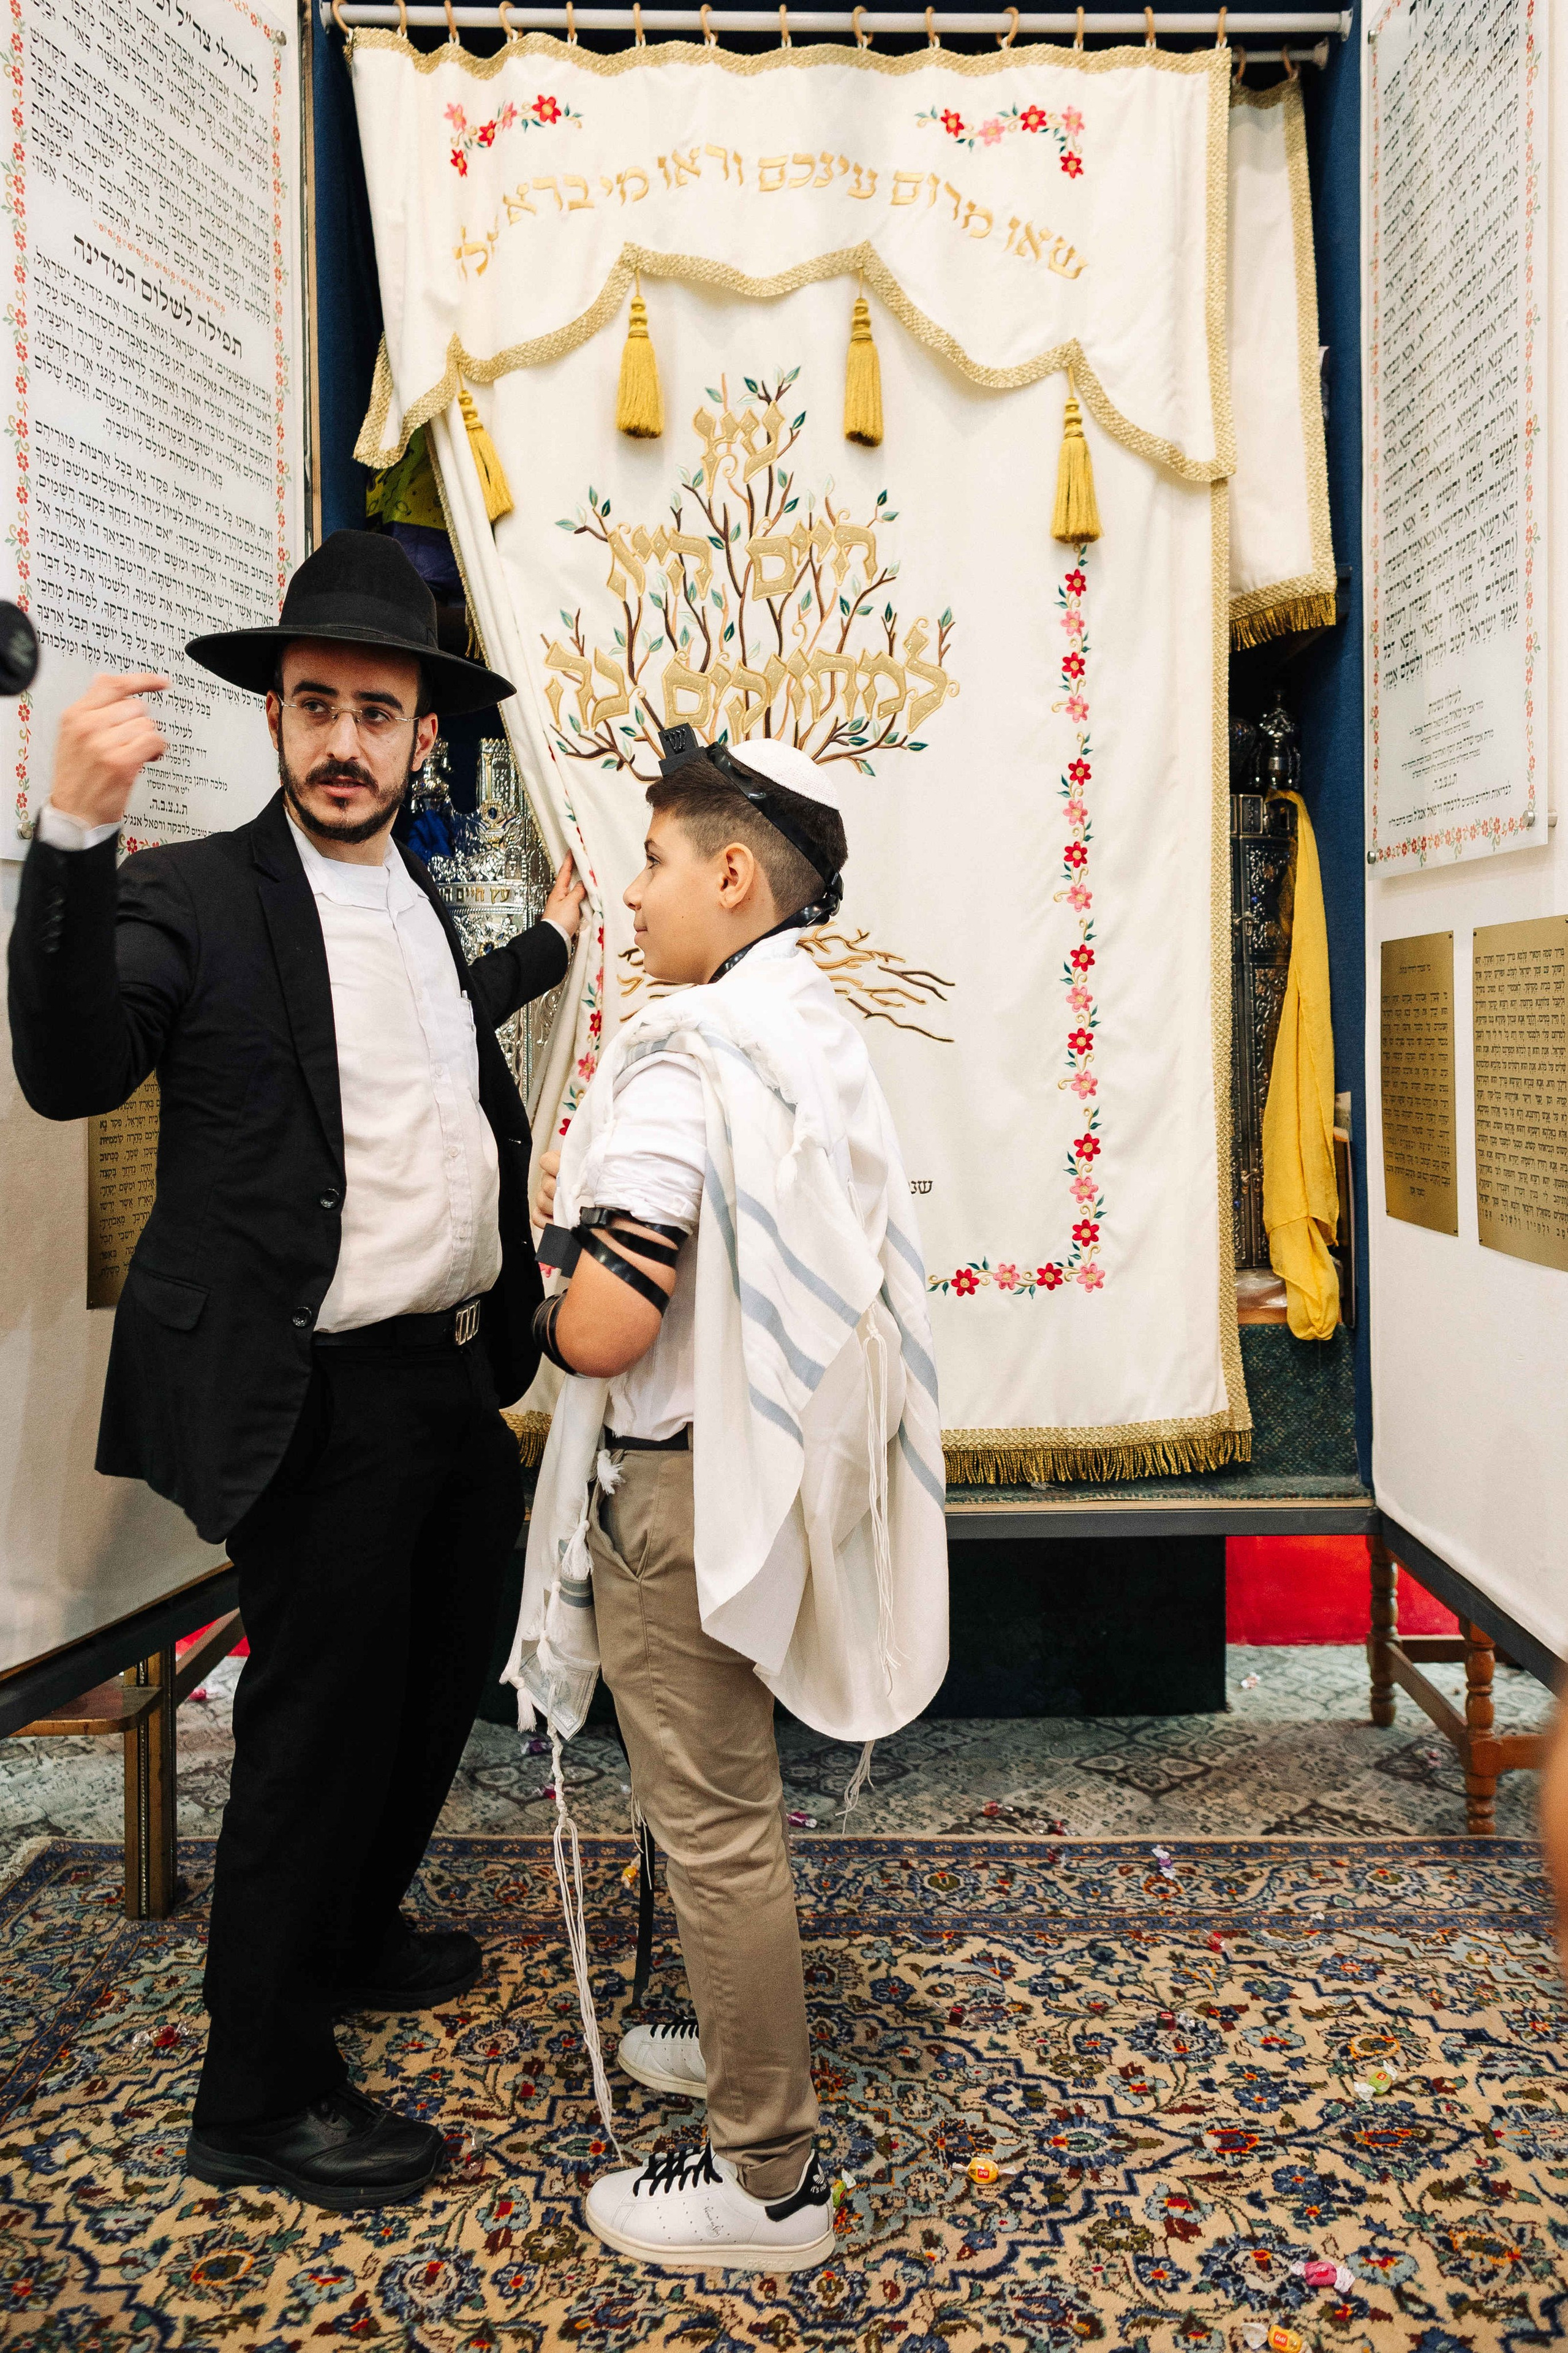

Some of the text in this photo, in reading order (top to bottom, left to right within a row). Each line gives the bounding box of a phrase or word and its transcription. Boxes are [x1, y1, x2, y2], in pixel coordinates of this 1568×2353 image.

[657, 143, 743, 190] וראו
[890, 170, 993, 239] מרום
[1003, 215, 1089, 279] שאו
[74, 235, 241, 358] תפילה לשלום המדינה
[693, 401, 785, 498] עץ
[606, 508, 877, 602] חיים היא
[544, 616, 959, 743] למחזיקים בה
[168, 720, 192, 738] לעילוי
[456, 887, 485, 902] חיים
[491, 887, 511, 904] עץ
